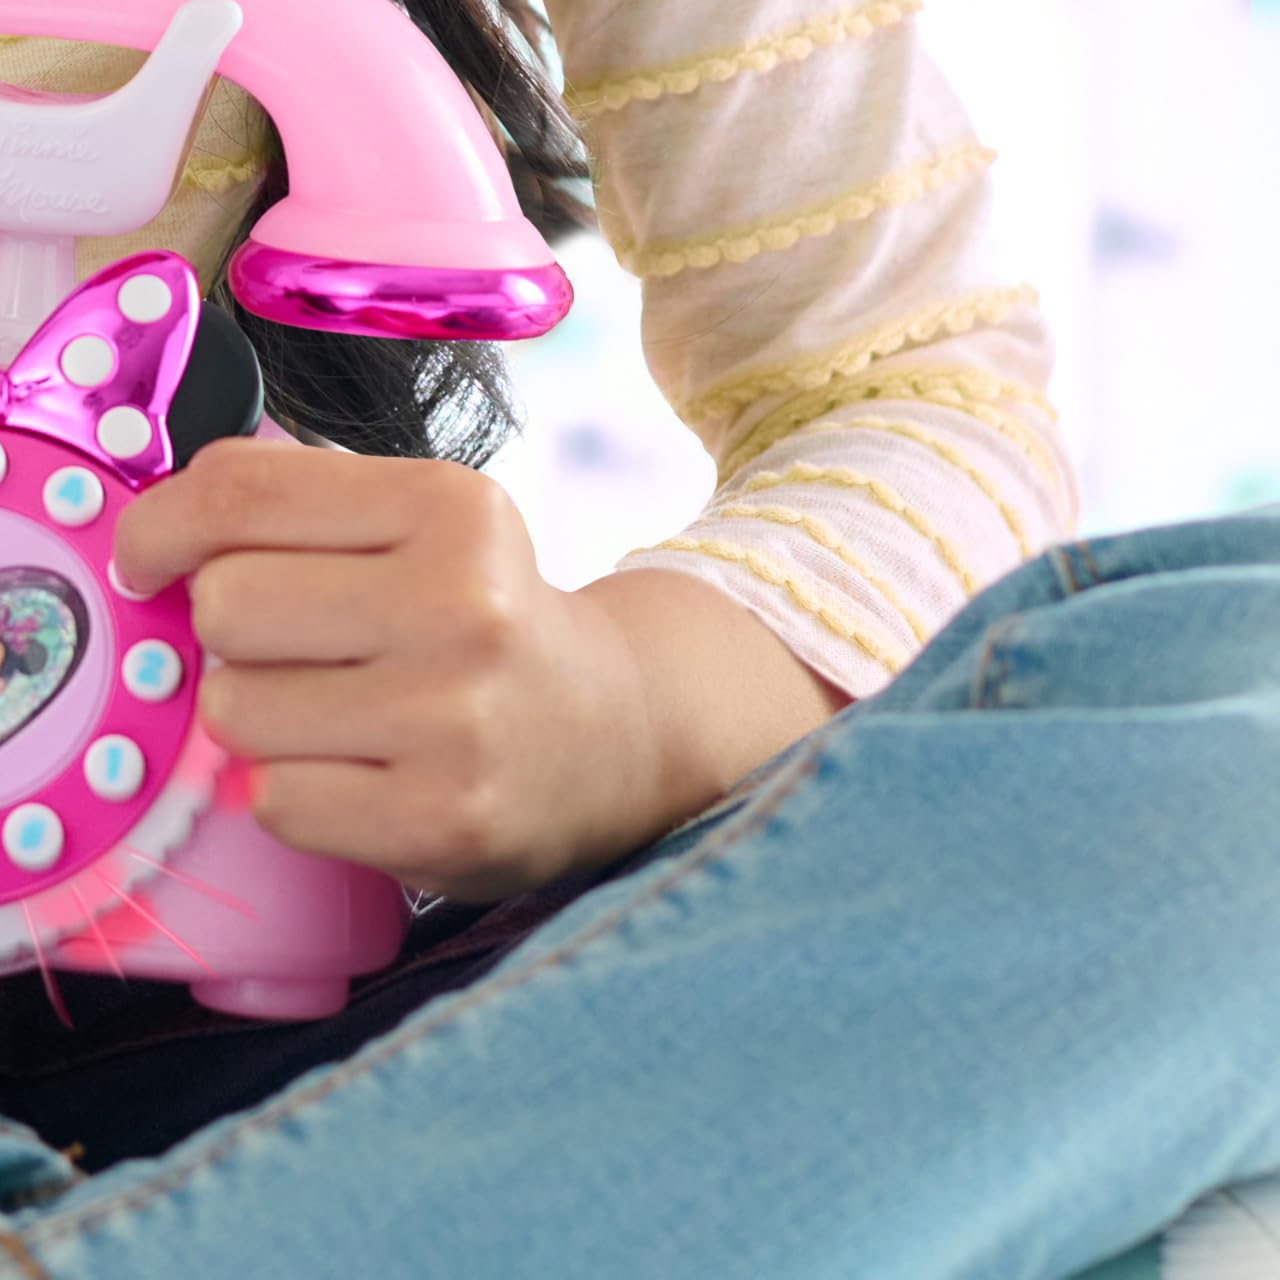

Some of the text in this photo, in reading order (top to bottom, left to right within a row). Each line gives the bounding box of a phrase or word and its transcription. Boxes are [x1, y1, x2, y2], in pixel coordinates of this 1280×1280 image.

[56, 475, 86, 507] 4
[137, 650, 166, 687] 2
[105, 745, 123, 783] 1
